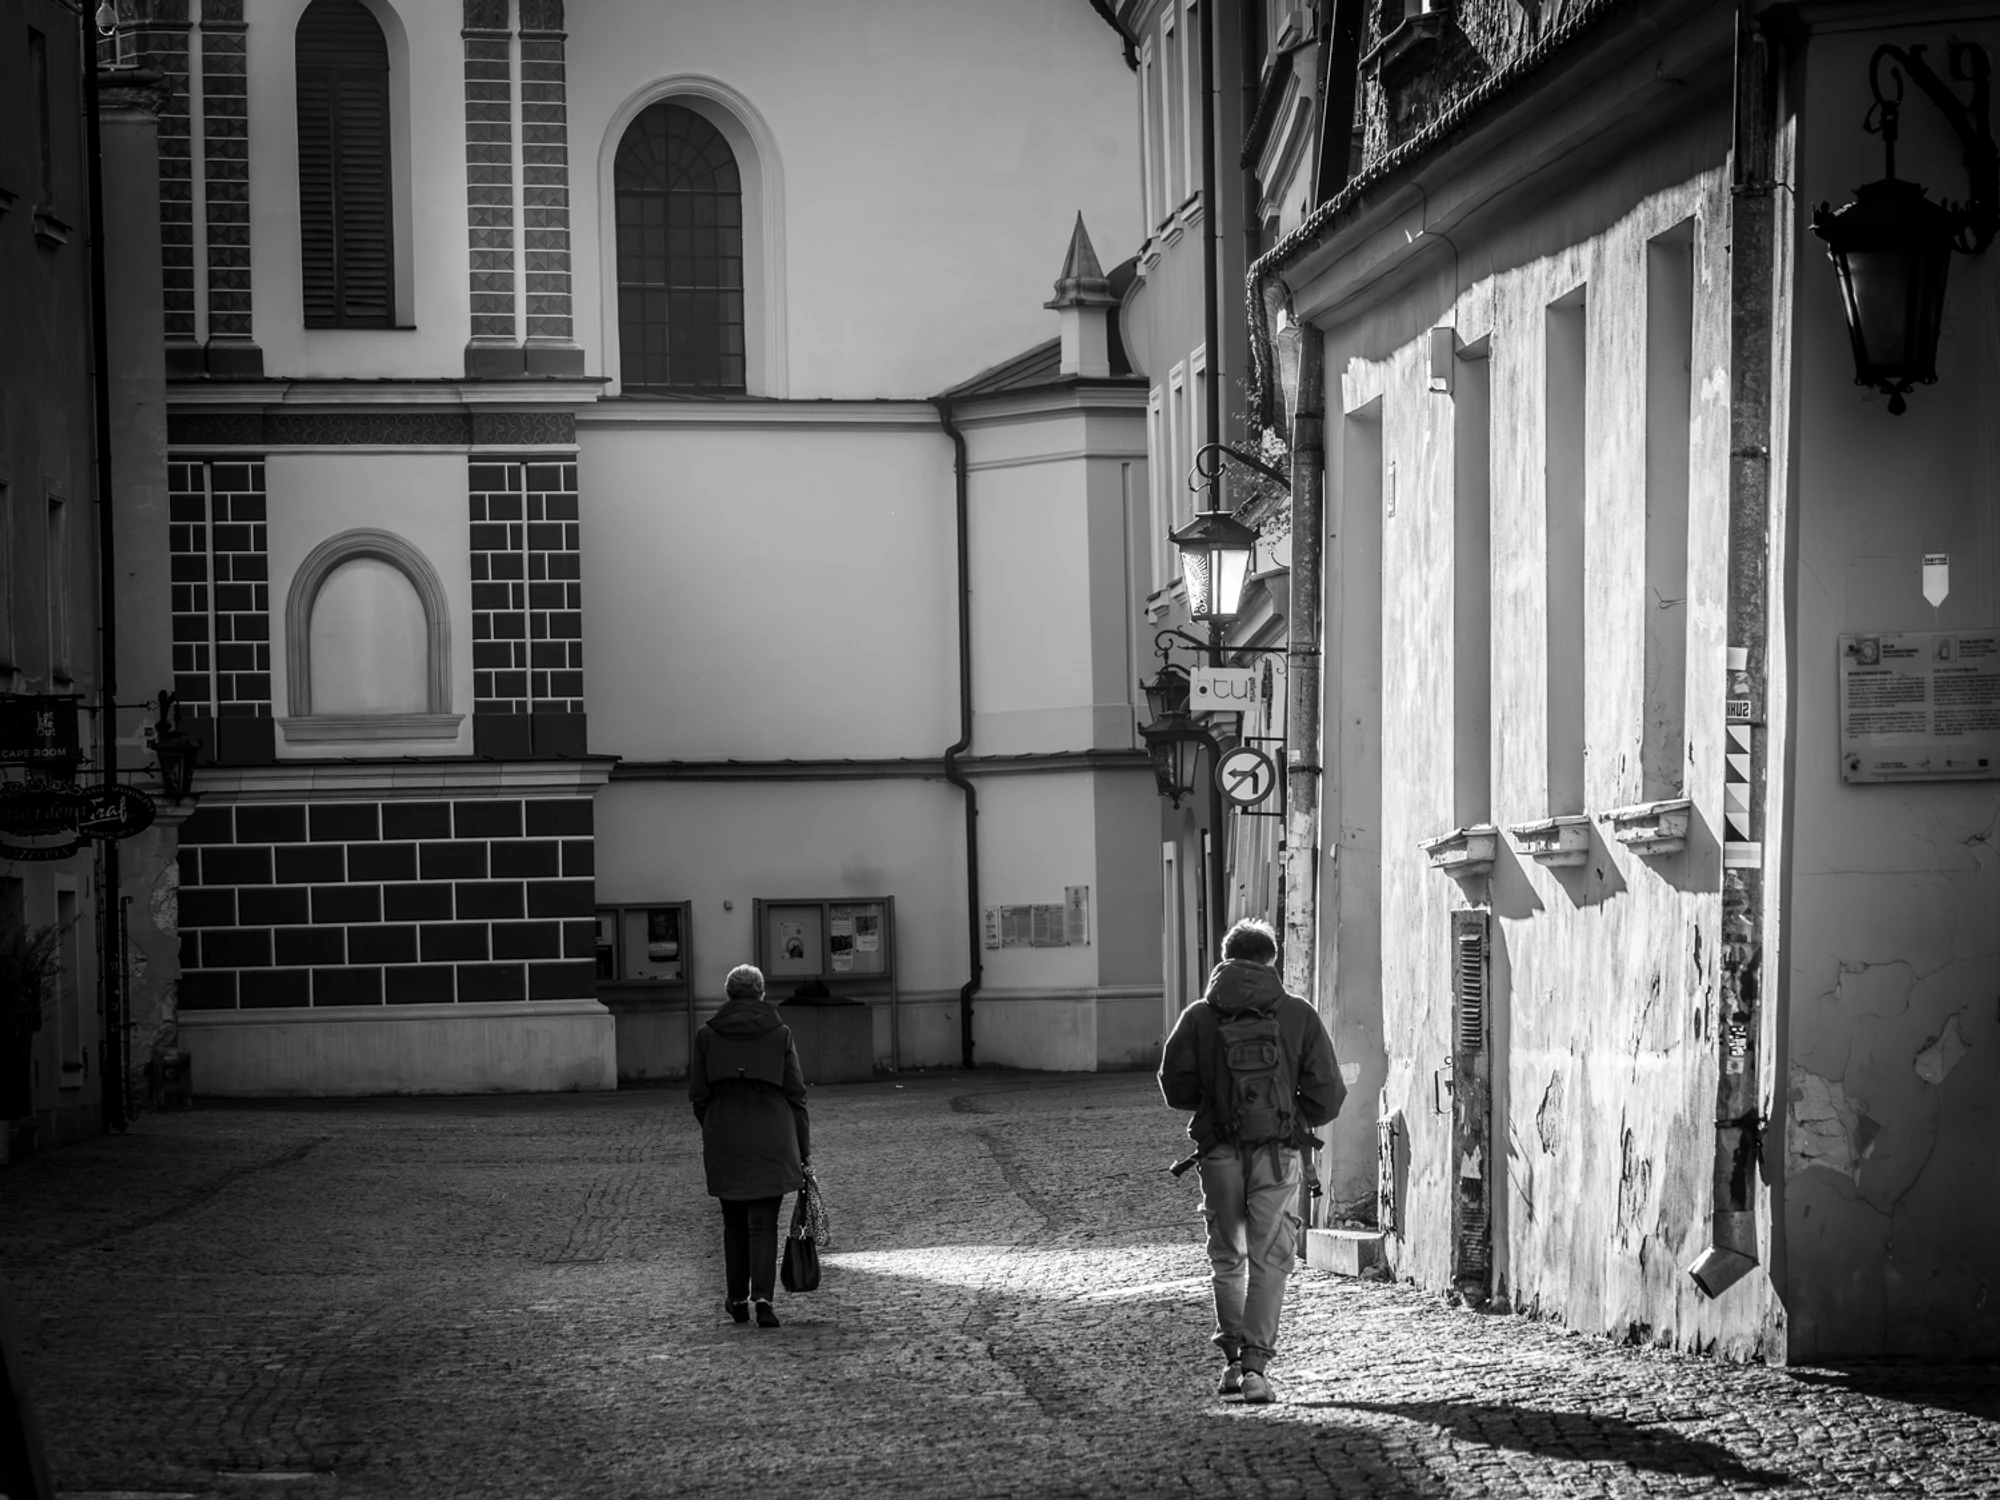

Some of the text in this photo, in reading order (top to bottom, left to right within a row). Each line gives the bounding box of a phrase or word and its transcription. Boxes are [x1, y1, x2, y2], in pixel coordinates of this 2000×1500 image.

[36, 711, 55, 720] Let
[37, 719, 55, 728] Me
[36, 727, 57, 738] Out
[33, 748, 67, 757] ROOM
